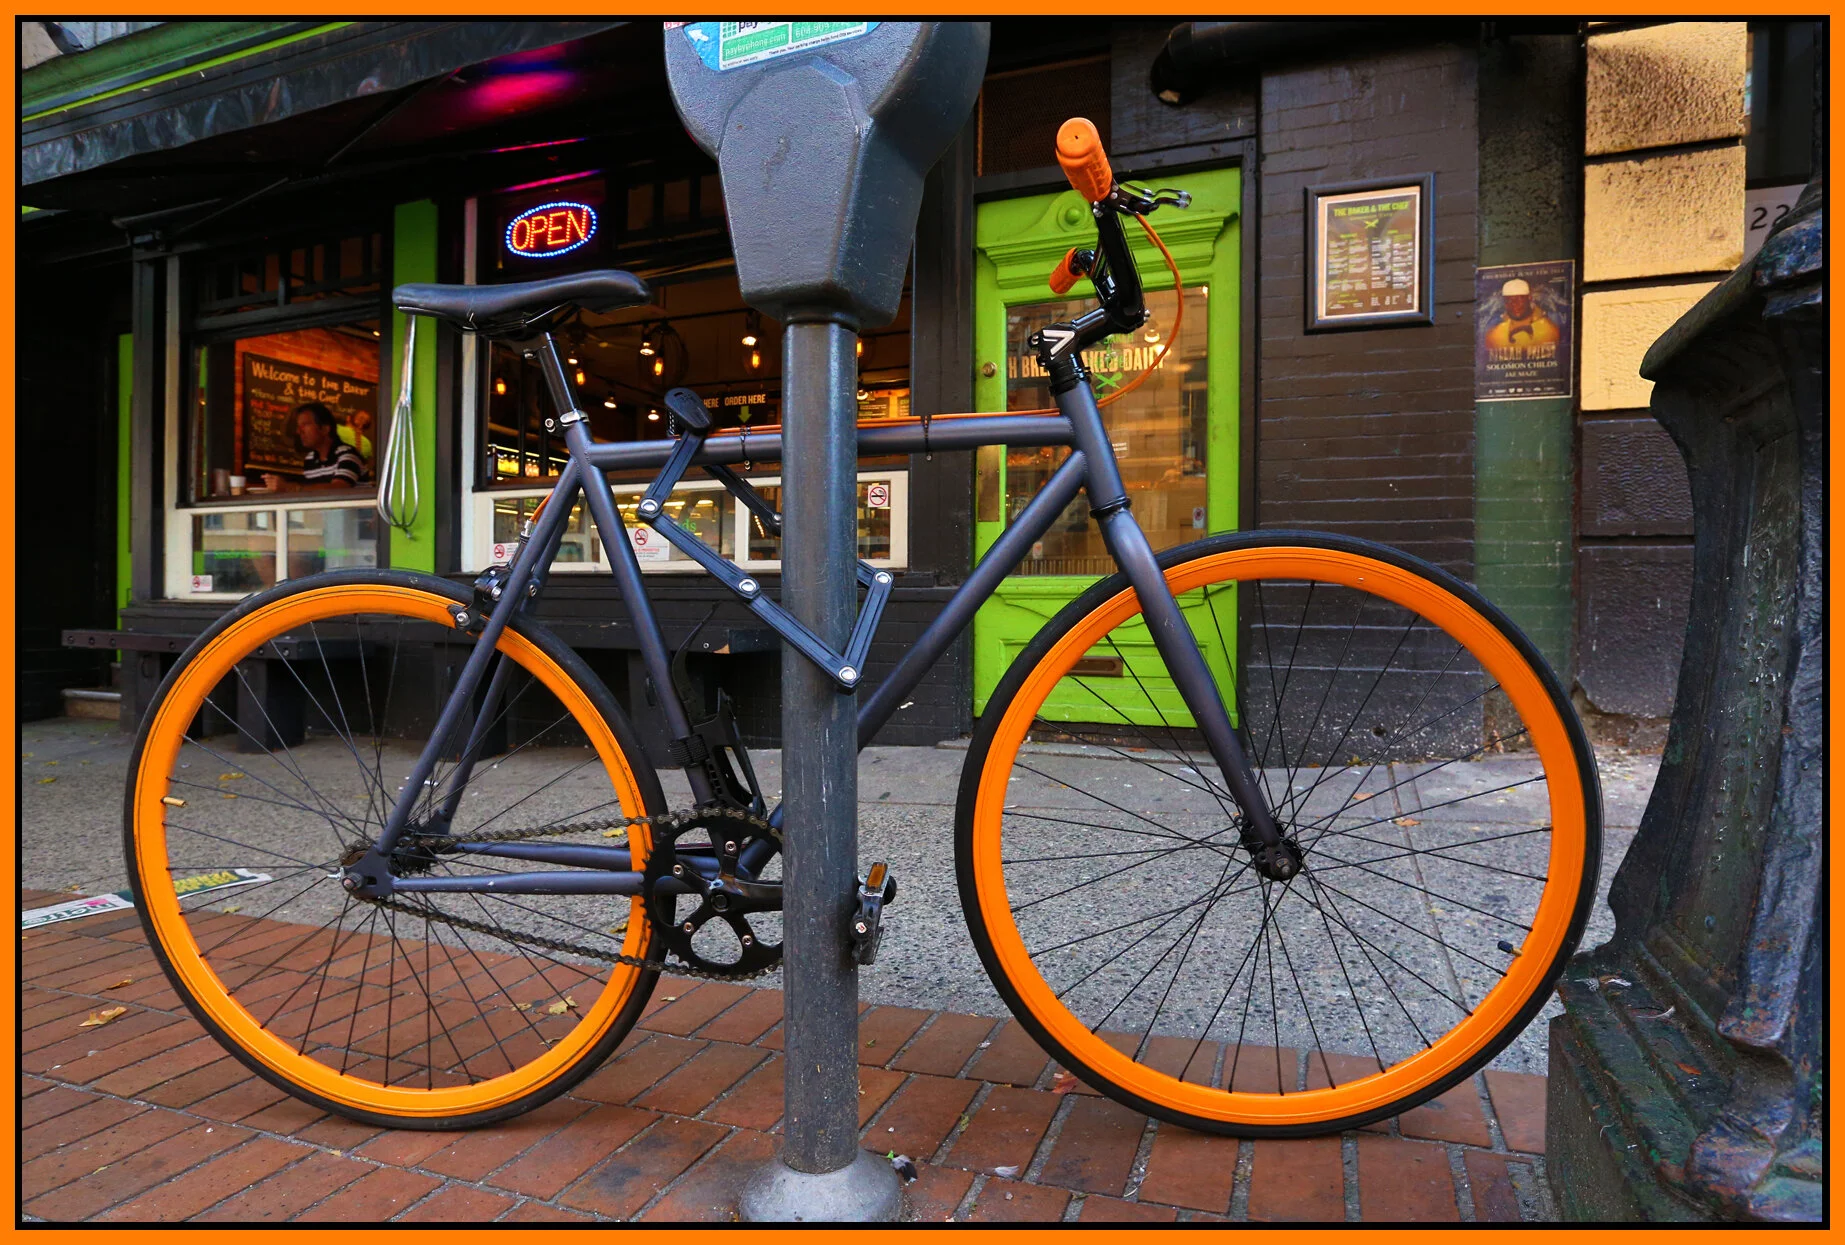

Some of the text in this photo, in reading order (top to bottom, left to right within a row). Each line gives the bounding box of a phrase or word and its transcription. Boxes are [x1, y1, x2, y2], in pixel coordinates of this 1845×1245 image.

[725, 33, 786, 57] paybyphone.com
[512, 208, 588, 250] OPEN
[1486, 360, 1559, 370] SOLOMON CHILDS
[303, 373, 316, 386] to
[725, 396, 747, 406] ORDER
[748, 394, 766, 405] HERE
